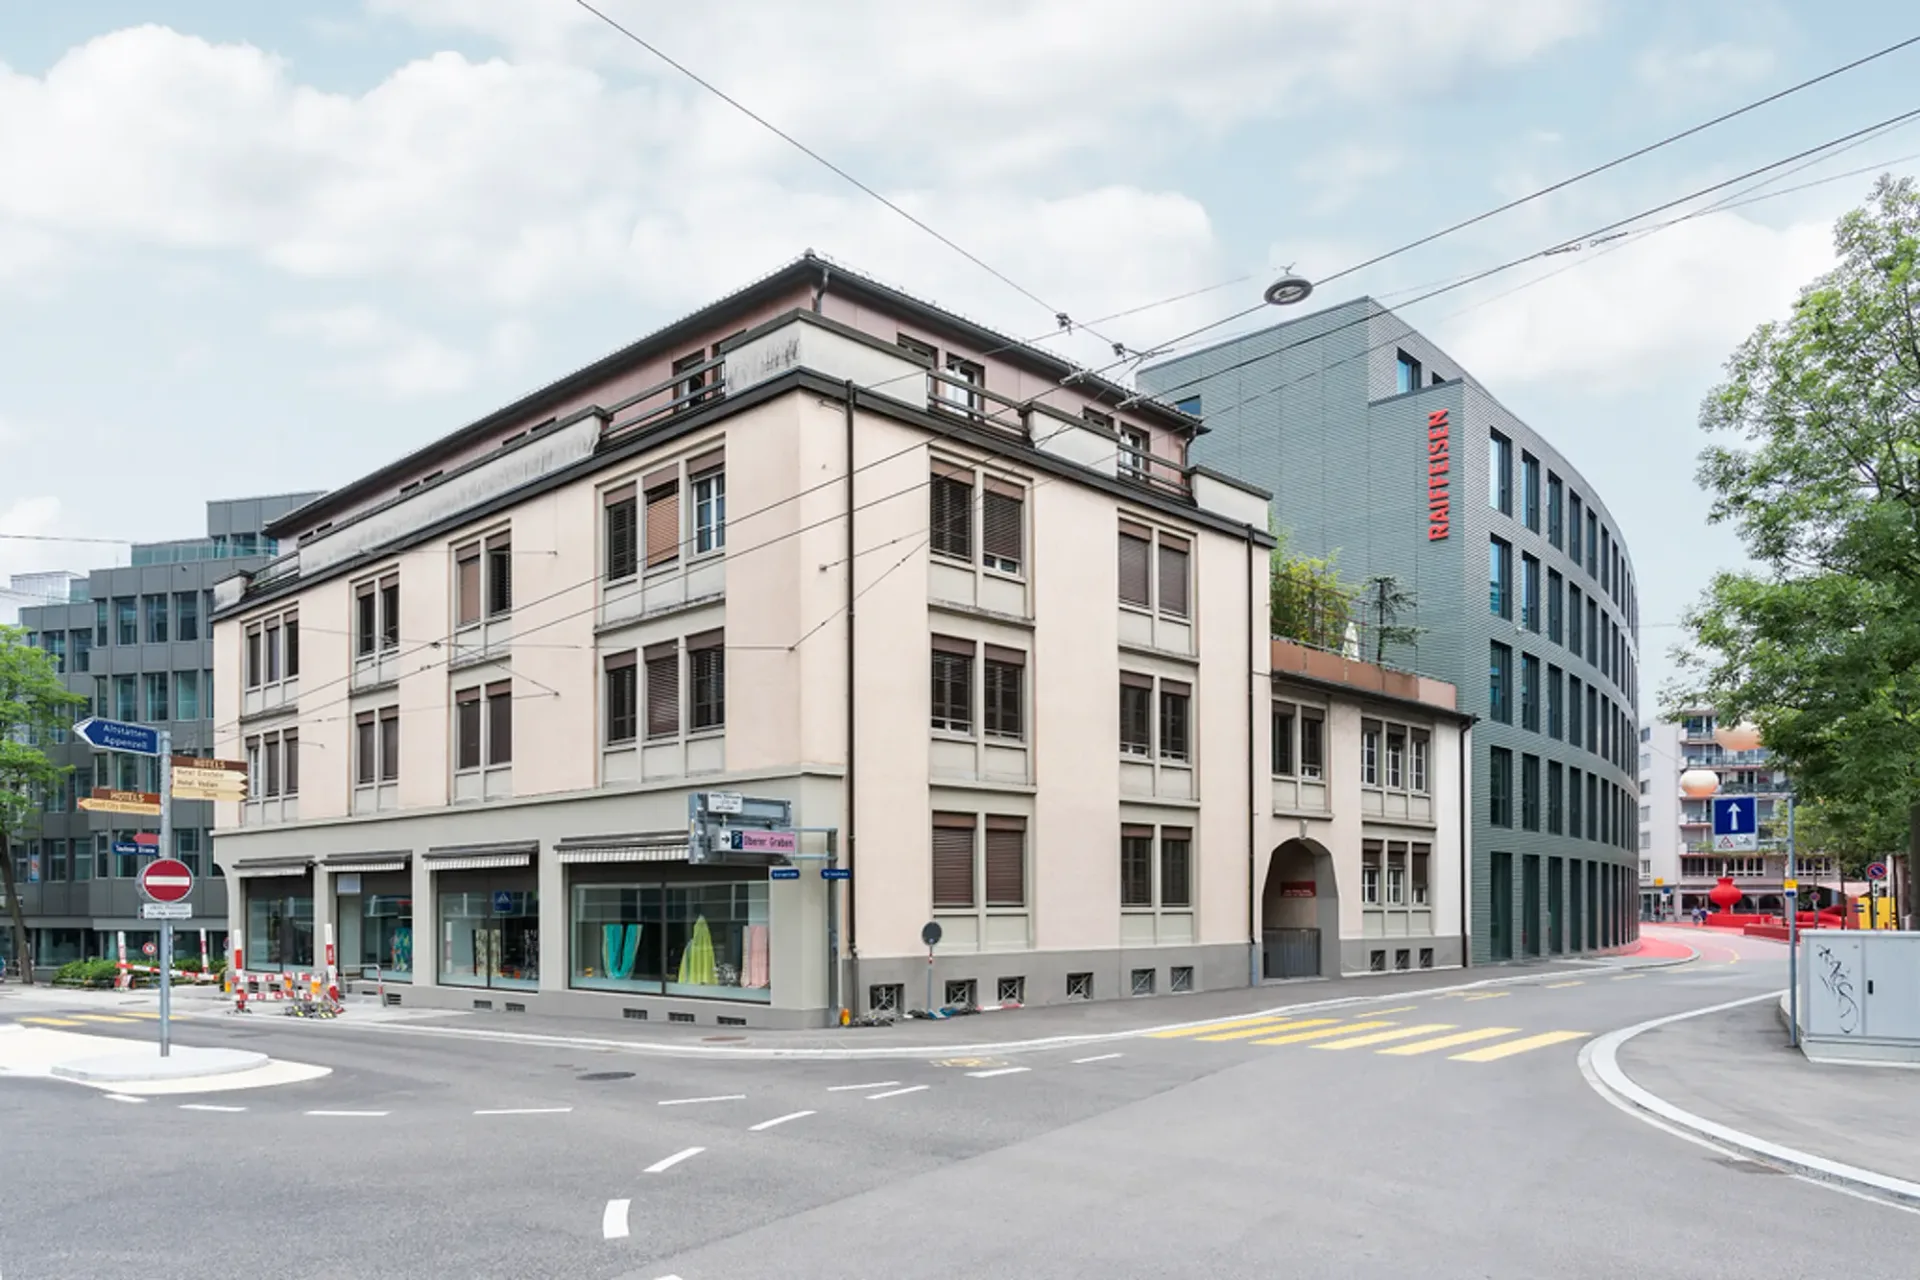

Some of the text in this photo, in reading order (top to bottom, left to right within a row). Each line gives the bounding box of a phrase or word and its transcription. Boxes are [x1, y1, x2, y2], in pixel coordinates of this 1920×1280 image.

[1428, 407, 1450, 542] RAIFFEISEN
[103, 736, 148, 749] Appenzell
[110, 791, 145, 803] HOTELS
[744, 834, 767, 846] Oberer
[769, 836, 794, 848] Graben
